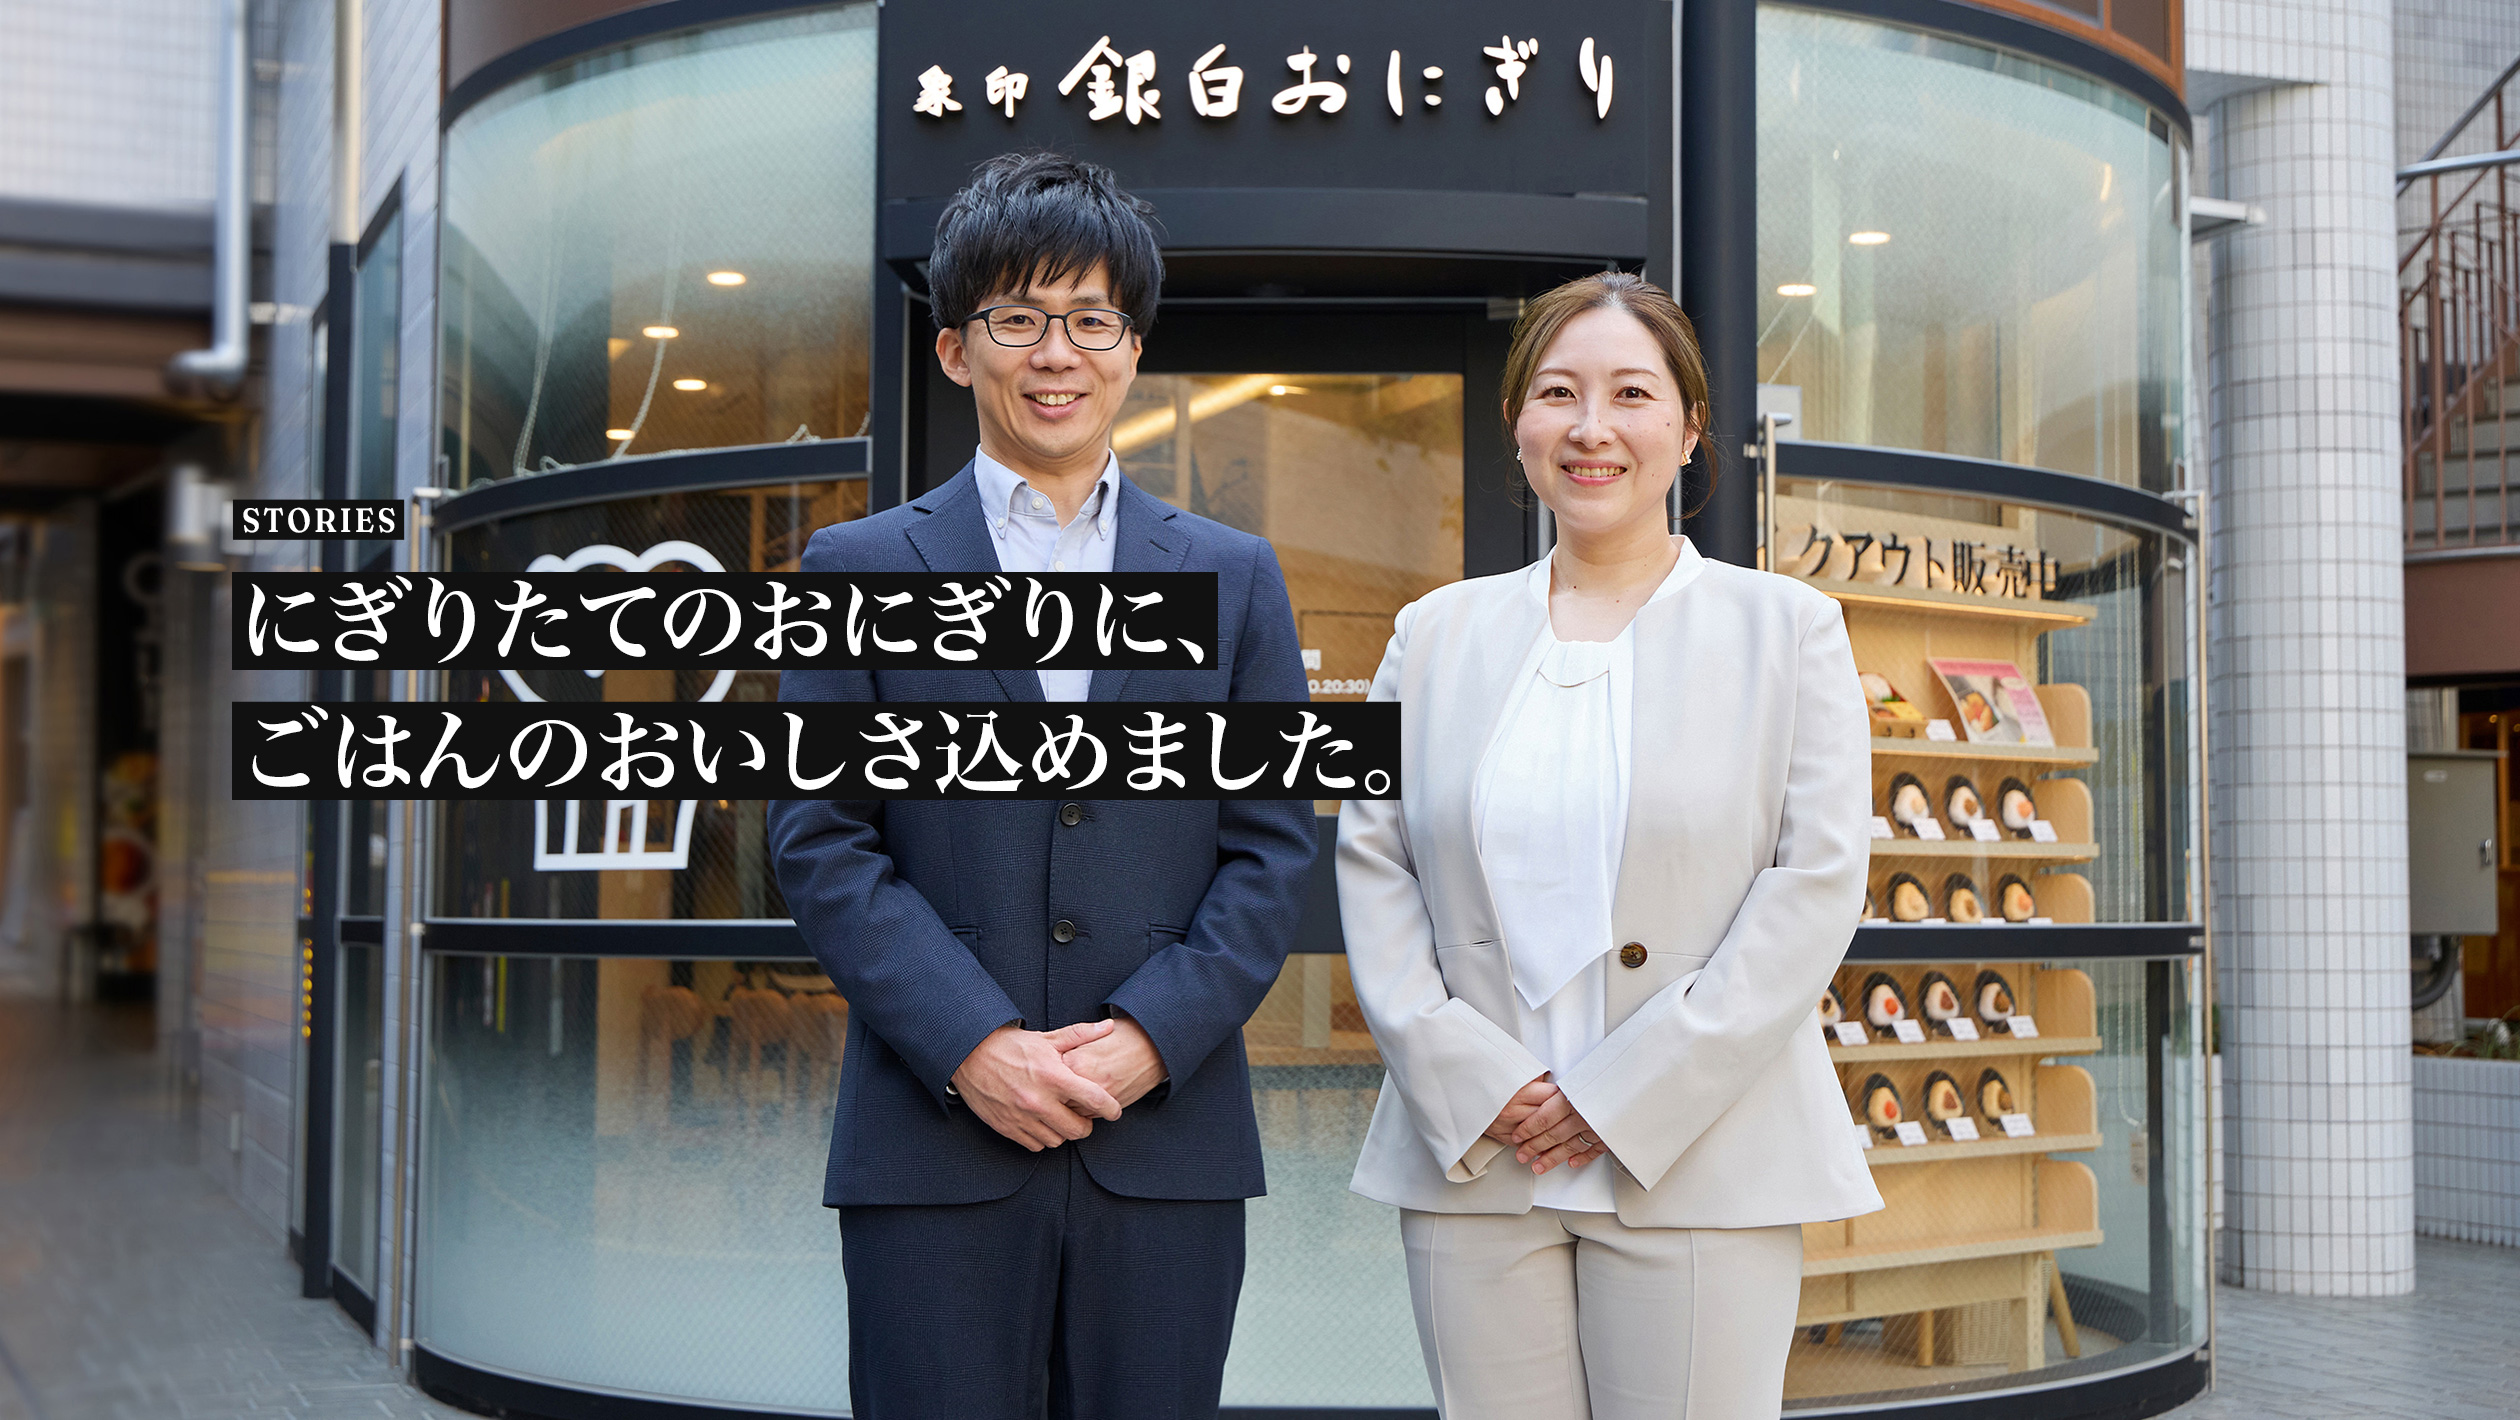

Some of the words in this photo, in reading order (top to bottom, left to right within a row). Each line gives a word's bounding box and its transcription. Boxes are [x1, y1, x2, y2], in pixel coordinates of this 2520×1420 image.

[1775, 523, 2061, 601] クアウト販売中
